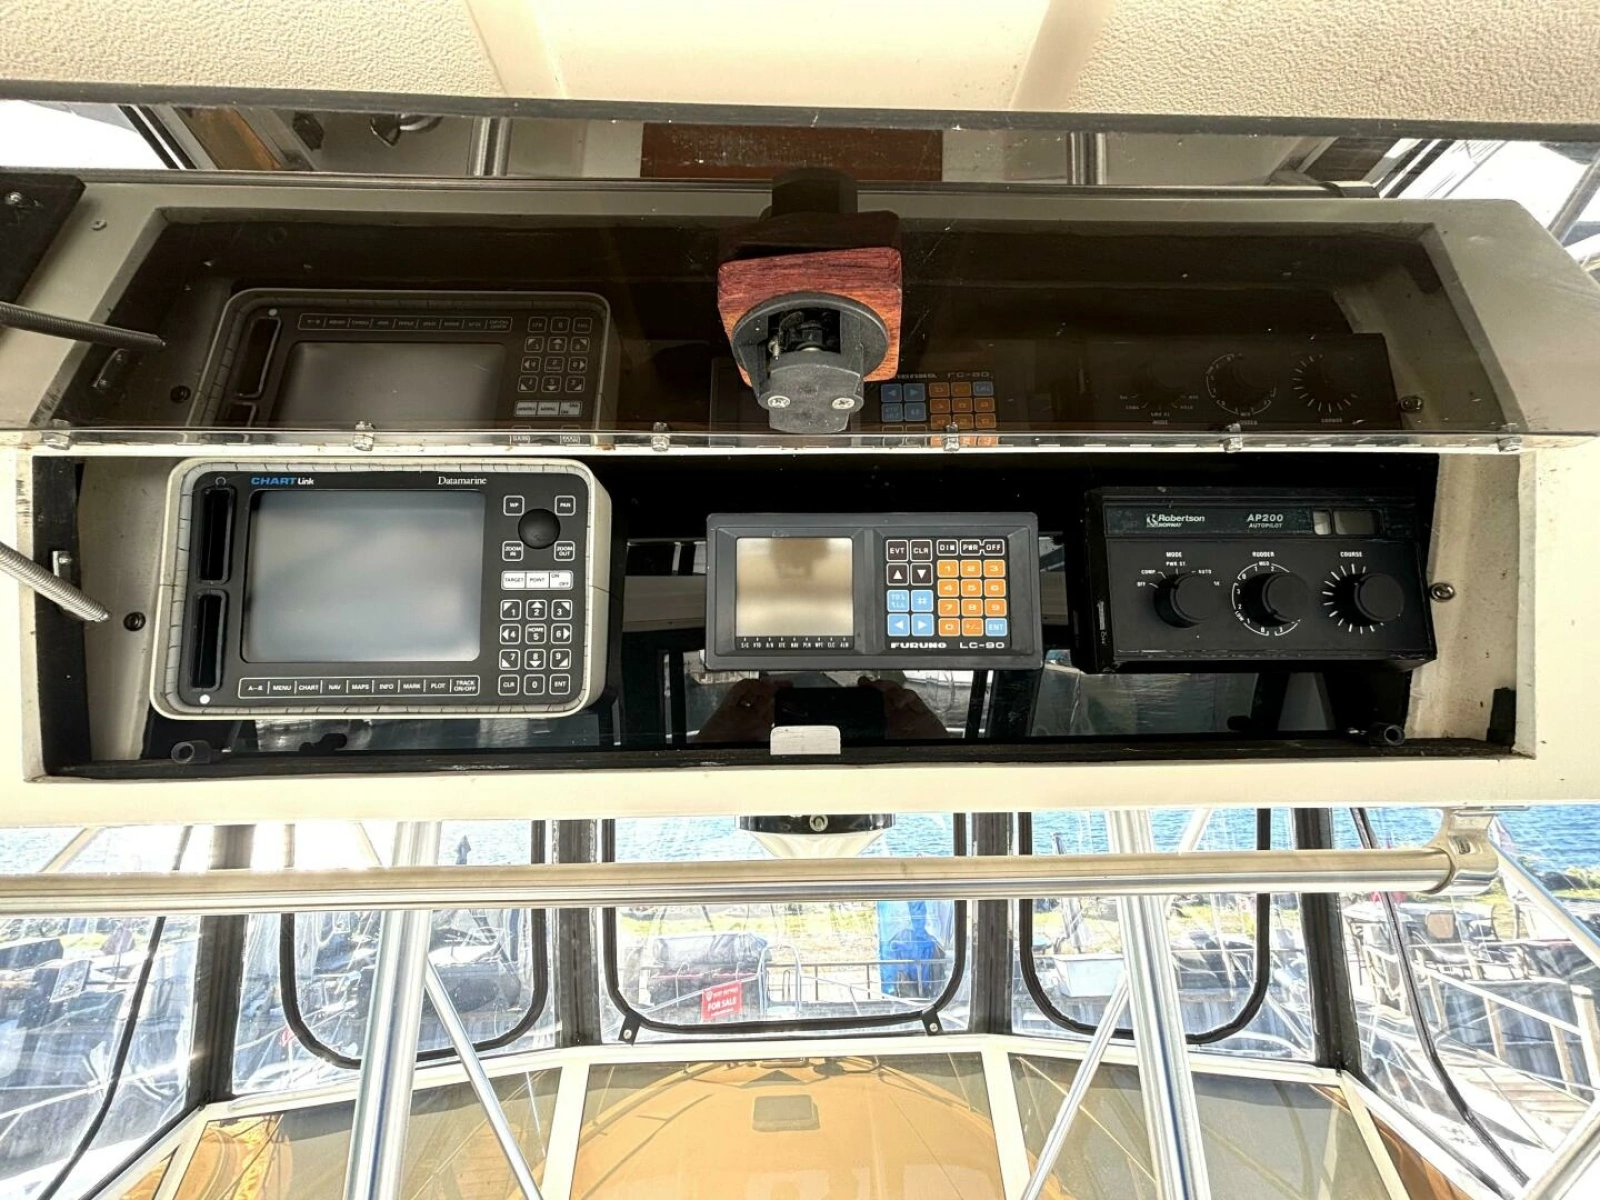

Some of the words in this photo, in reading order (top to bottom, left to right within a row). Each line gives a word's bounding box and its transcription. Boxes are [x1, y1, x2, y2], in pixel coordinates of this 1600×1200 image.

[250, 477, 297, 485] CHART
[297, 477, 314, 485] Link
[437, 476, 487, 485] Datamarine
[1158, 513, 1206, 522] Robertson
[1247, 513, 1284, 522] AP200
[943, 584, 953, 592] 4
[556, 608, 563, 616] 3
[988, 623, 1004, 631] ENT
[510, 630, 516, 638] 4
[533, 633, 540, 641] 5
[555, 630, 562, 638] 6
[510, 653, 516, 661] 7
[555, 652, 561, 660] 9
[532, 681, 538, 689] 0
